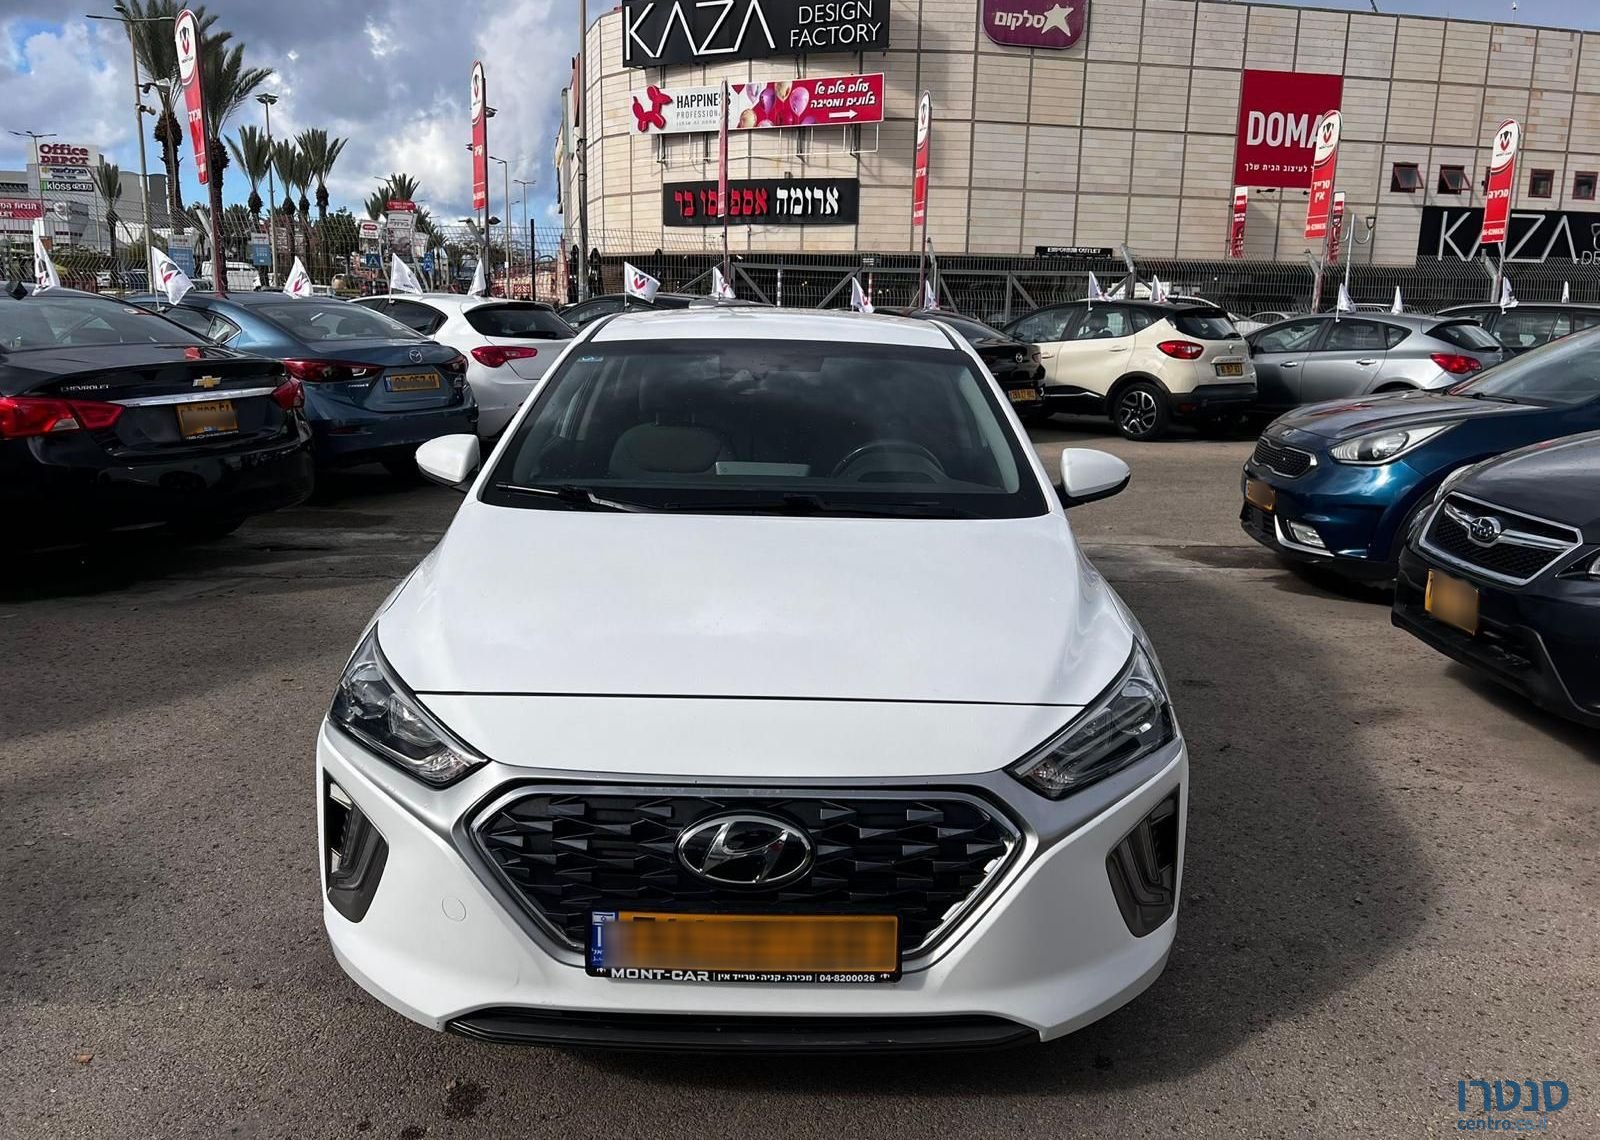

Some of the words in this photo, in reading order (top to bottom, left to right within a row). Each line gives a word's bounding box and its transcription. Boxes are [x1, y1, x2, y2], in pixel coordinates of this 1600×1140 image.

[798, 0, 873, 25] DESIGN
[994, 9, 1046, 31] סלקום
[625, 0, 776, 61] KAZA
[790, 22, 882, 48] FACTORY
[814, 81, 825, 95] של
[827, 80, 845, 95] שלם
[847, 78, 870, 94] עולם
[810, 98, 844, 109] ומסיבה
[846, 91, 876, 107] בלונים
[39, 143, 89, 156] Office
[40, 155, 89, 165] DEPOT
[1244, 162, 1260, 172] שלך
[47, 181, 72, 191] kloss
[674, 189, 695, 217] בר
[700, 187, 769, 216] אספסו
[776, 186, 839, 215] ארומה
[610, 967, 710, 982] MONT-CAR
